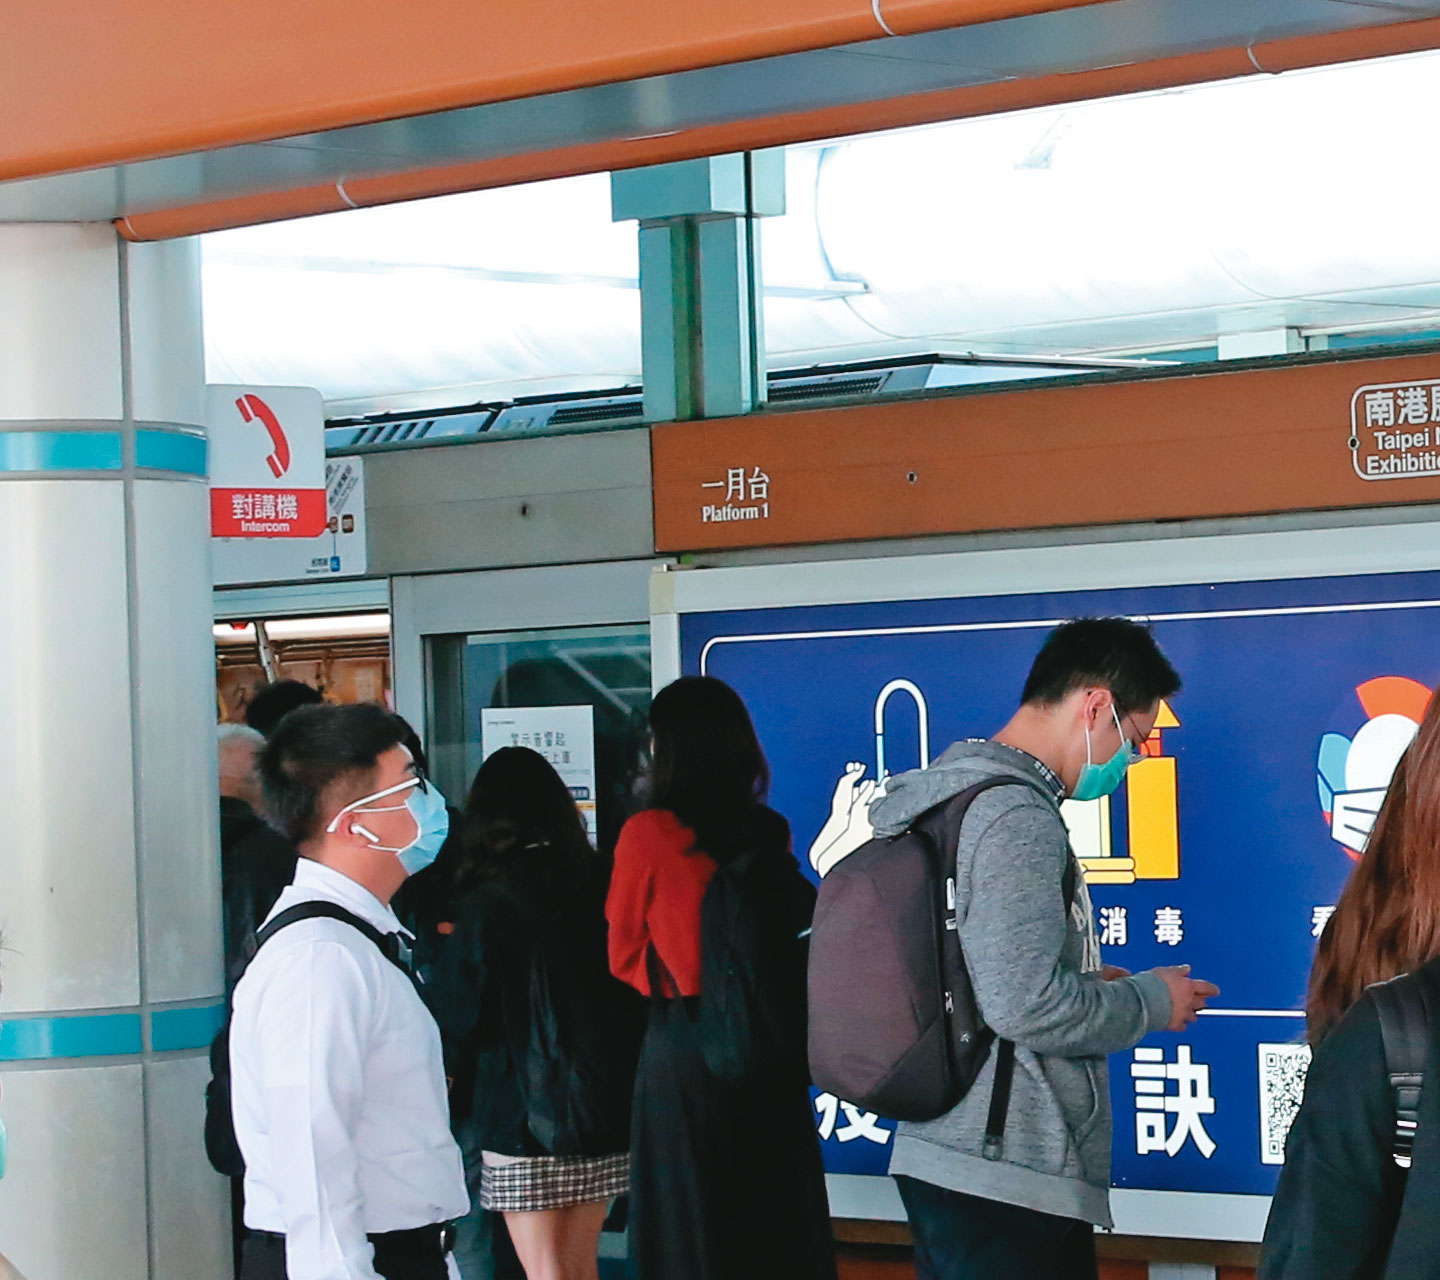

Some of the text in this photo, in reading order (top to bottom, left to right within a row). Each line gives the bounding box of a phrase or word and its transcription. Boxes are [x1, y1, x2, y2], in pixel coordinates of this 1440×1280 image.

[1373, 429, 1430, 455] Taipei
[700, 466, 771, 503] 一月台
[232, 493, 299, 521] 對講機
[701, 500, 770, 523] Platform 1
[240, 520, 290, 533] Intercom
[1098, 906, 1185, 946] 消毒
[1130, 1044, 1218, 1160] 訣
